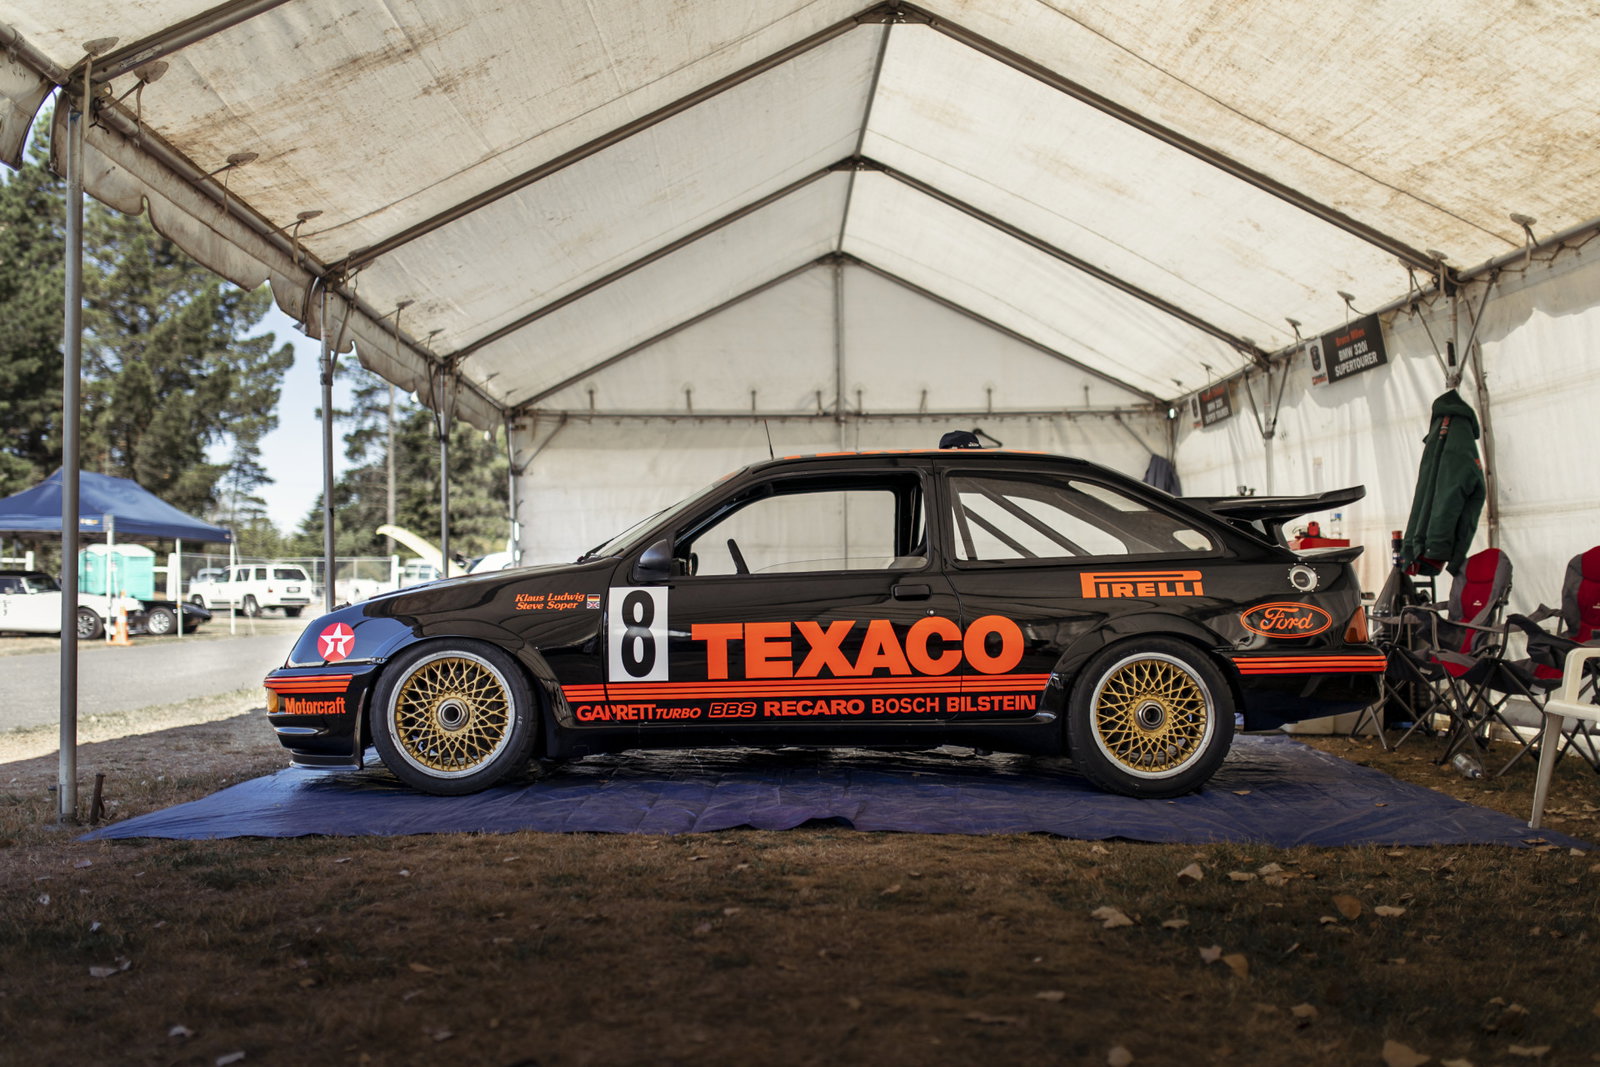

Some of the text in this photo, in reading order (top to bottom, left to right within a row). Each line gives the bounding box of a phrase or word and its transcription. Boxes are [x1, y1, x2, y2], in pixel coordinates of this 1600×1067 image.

[1338, 345, 1354, 362] BMW
[1080, 570, 1204, 599] PIRELLI
[514, 592, 586, 602] Klaus Ludwig
[515, 601, 579, 611] Steve Soper
[1260, 607, 1314, 630] Ford
[621, 589, 656, 678] 8
[691, 614, 1025, 680] TEXACO
[284, 696, 346, 715] Motorcraft
[708, 702, 757, 718] BBS
[763, 699, 865, 717] RECARO
[871, 697, 939, 714] BOSCH
[946, 695, 1036, 712] BILSTEIN
[655, 707, 702, 719] TURBO
